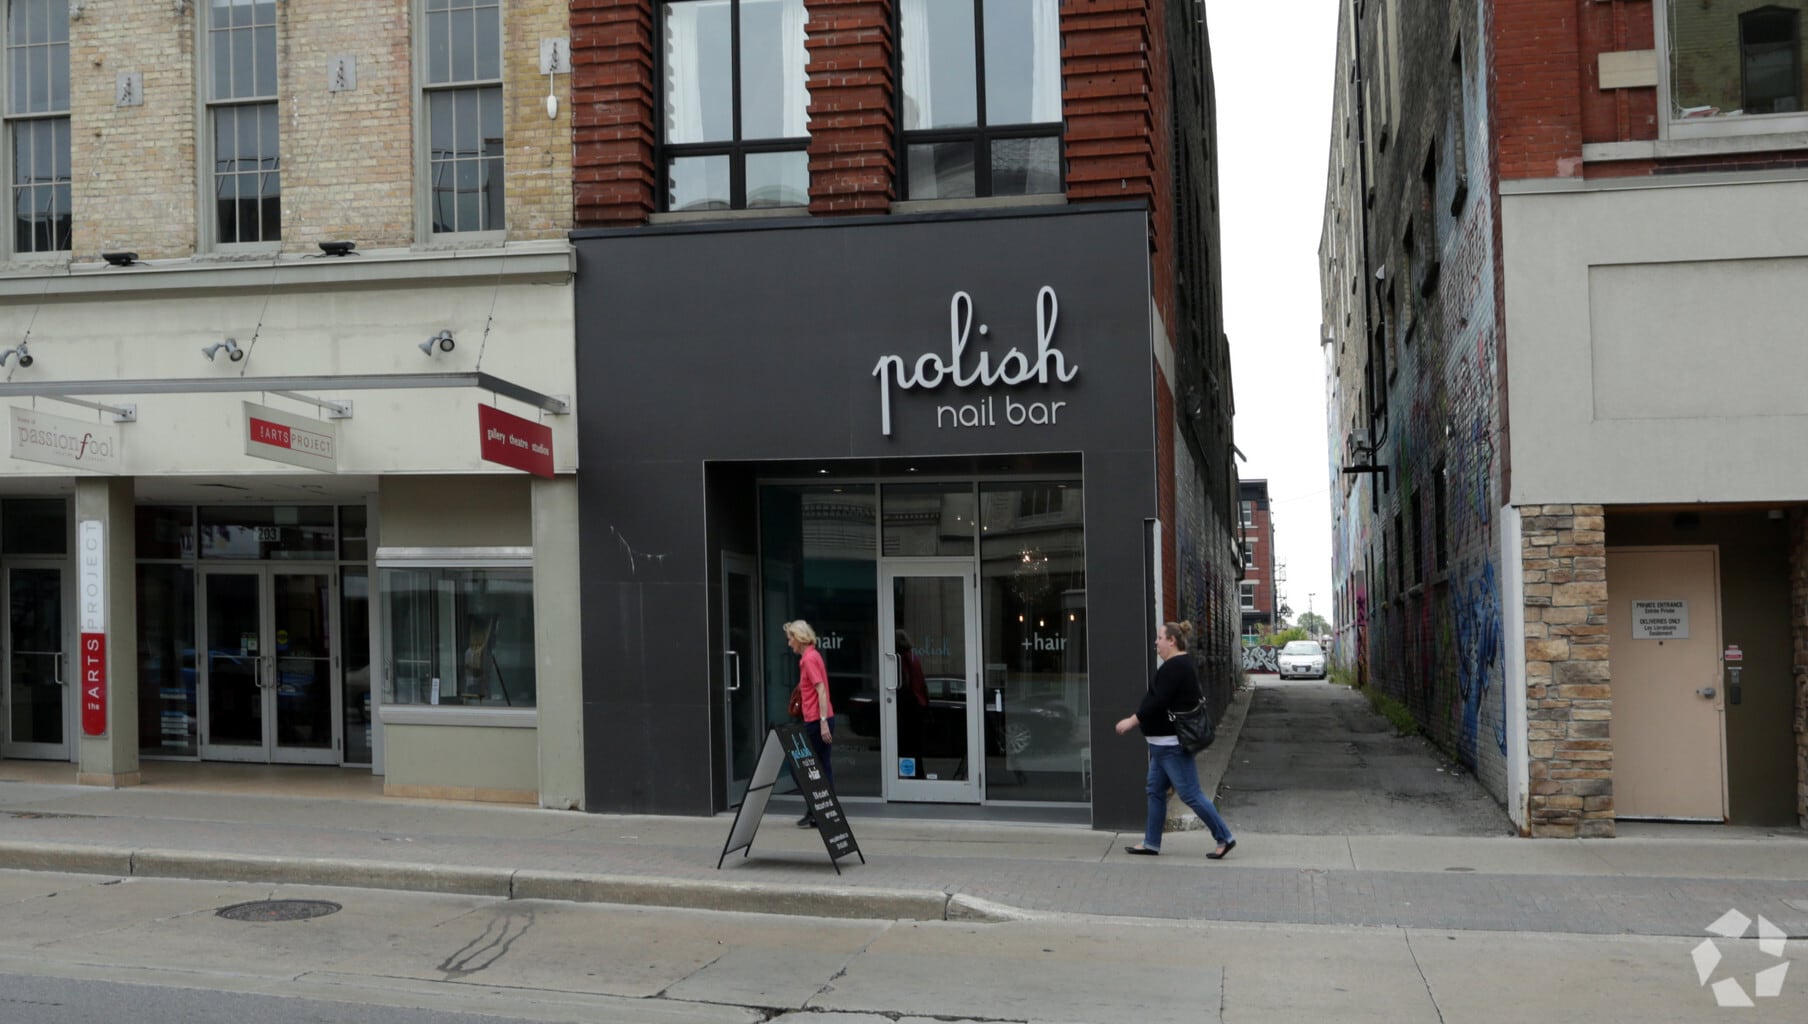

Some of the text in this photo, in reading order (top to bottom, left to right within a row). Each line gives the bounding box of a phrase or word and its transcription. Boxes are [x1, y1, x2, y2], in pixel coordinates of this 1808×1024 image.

[872, 285, 1079, 436] polish
[937, 395, 1067, 428] nail bar
[264, 428, 289, 444] ARTS
[291, 433, 330, 453] PROJECT
[487, 428, 550, 457] gallery theatre studios
[258, 527, 277, 541] 203
[86, 523, 98, 631] PROJECT
[1021, 631, 1068, 651] +hair
[87, 639, 100, 699] ARTS
